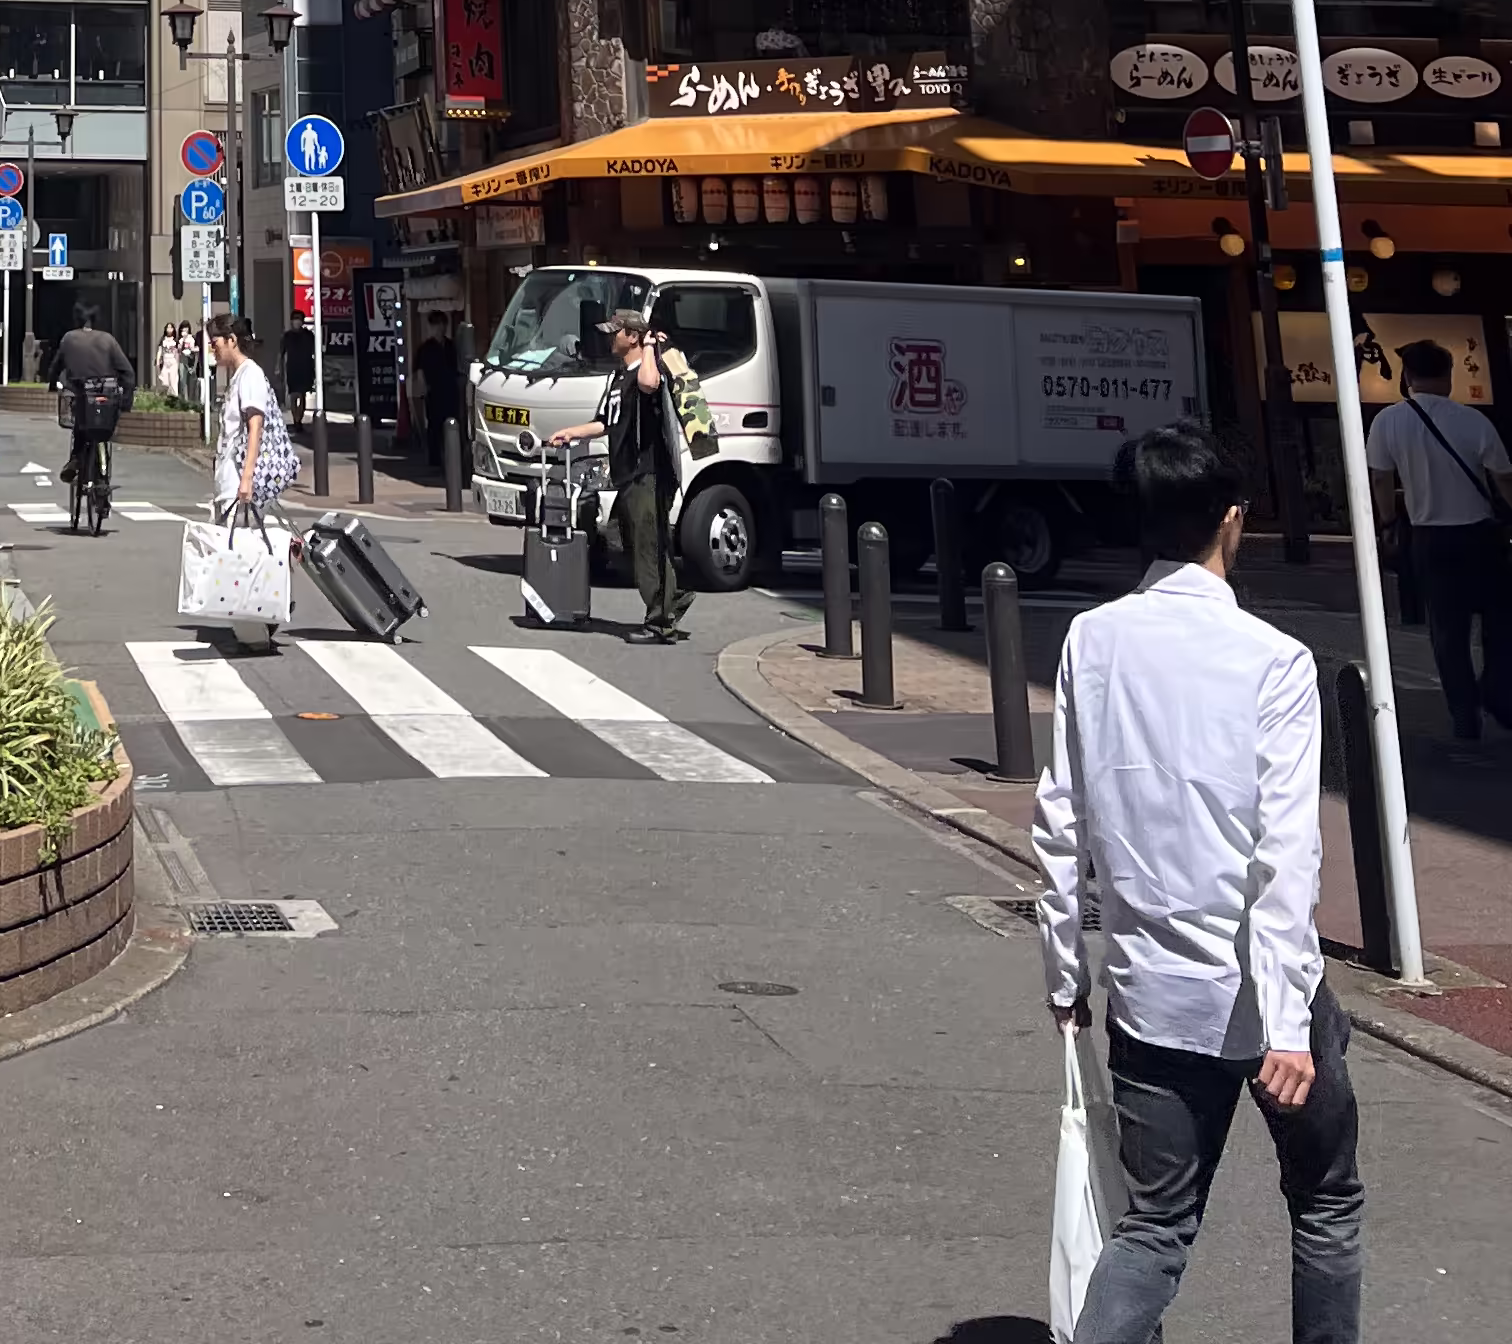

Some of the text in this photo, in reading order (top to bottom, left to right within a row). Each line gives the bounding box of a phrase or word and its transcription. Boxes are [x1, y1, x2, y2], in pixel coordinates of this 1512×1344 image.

[1128, 63, 1194, 89] らーめん
[1249, 68, 1299, 91] ーめん
[1336, 62, 1402, 88] ぎょうざ
[1431, 66, 1494, 86] 生ビール
[605, 157, 679, 176] KADOYA
[769, 153, 806, 171] キリン
[928, 155, 1012, 189] KADOYA
[469, 177, 502, 199] キリン
[191, 189, 209, 220] P
[291, 194, 338, 207] 12-20
[330, 331, 354, 346] KF
[366, 335, 396, 353] KF
[1042, 374, 1175, 401] 0570-011-477
